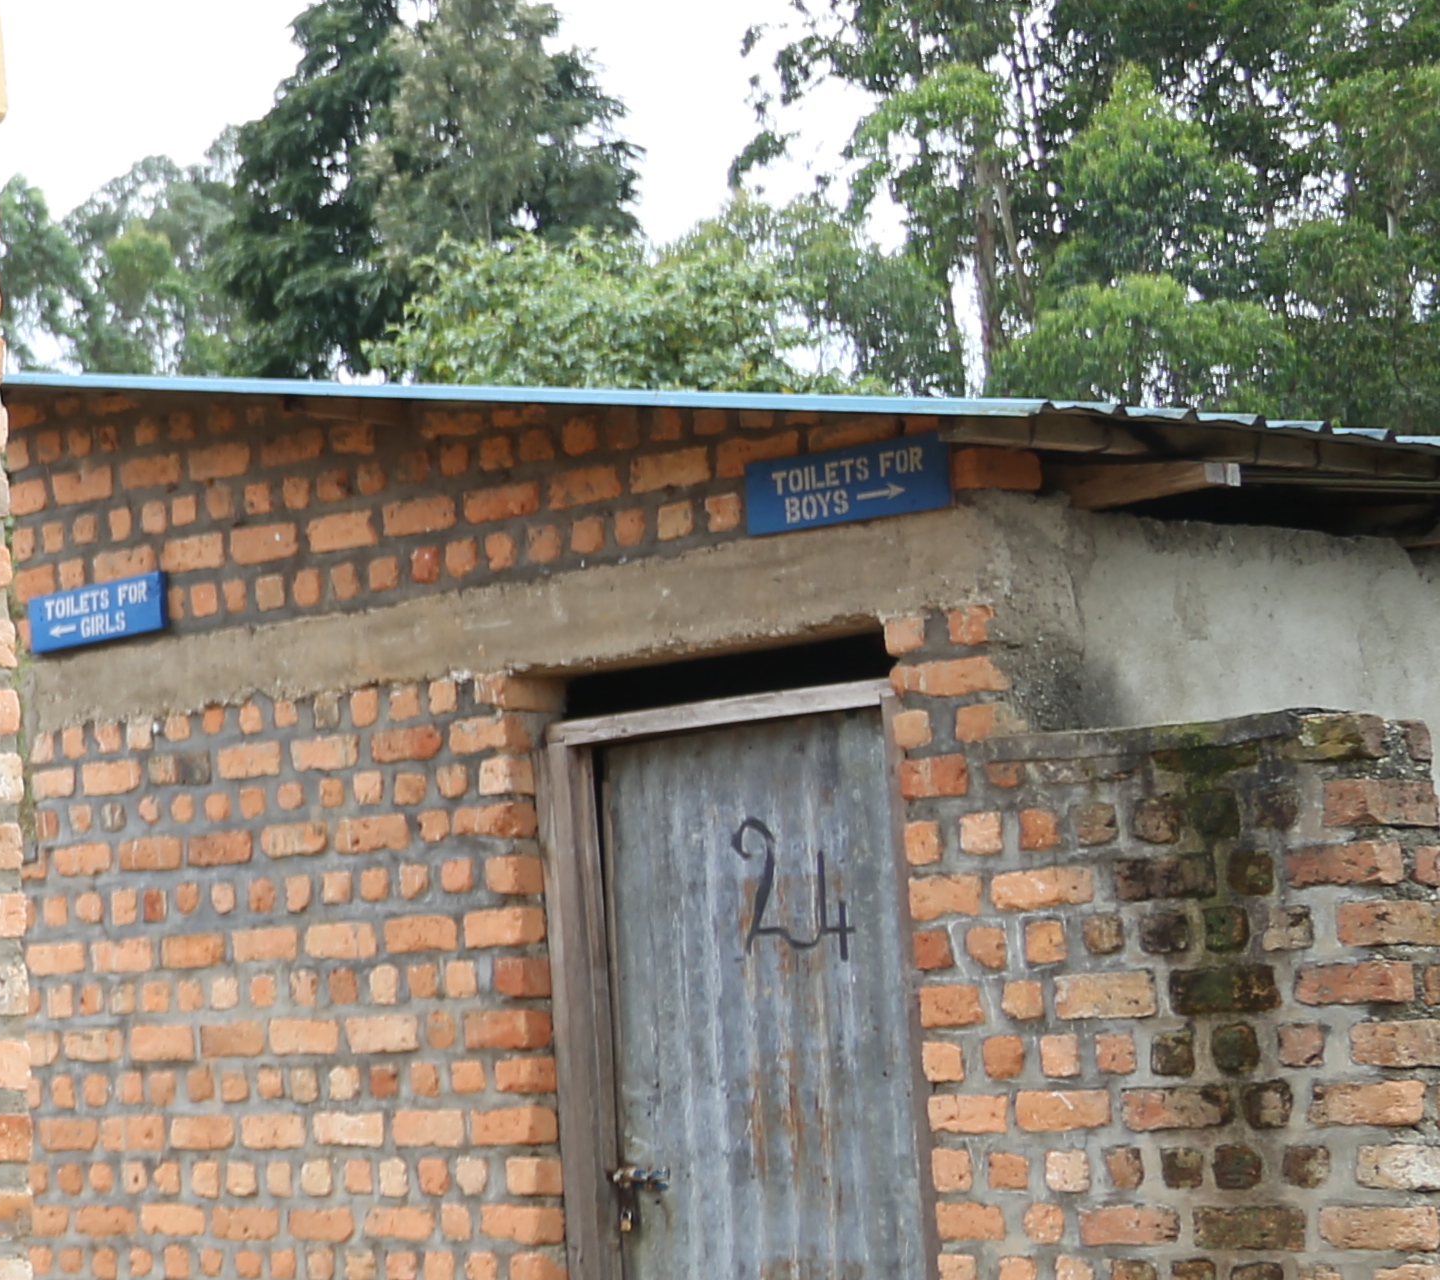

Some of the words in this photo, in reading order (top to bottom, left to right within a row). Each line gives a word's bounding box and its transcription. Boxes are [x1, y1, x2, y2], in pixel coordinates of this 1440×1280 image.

[771, 457, 869, 496] TOILETS
[879, 446, 924, 478] FOR
[784, 488, 850, 524] BOYS
[44, 588, 110, 621] TOILETS
[117, 579, 148, 607] FOR
[80, 610, 127, 639] GIRLS
[730, 816, 857, 961] 24
